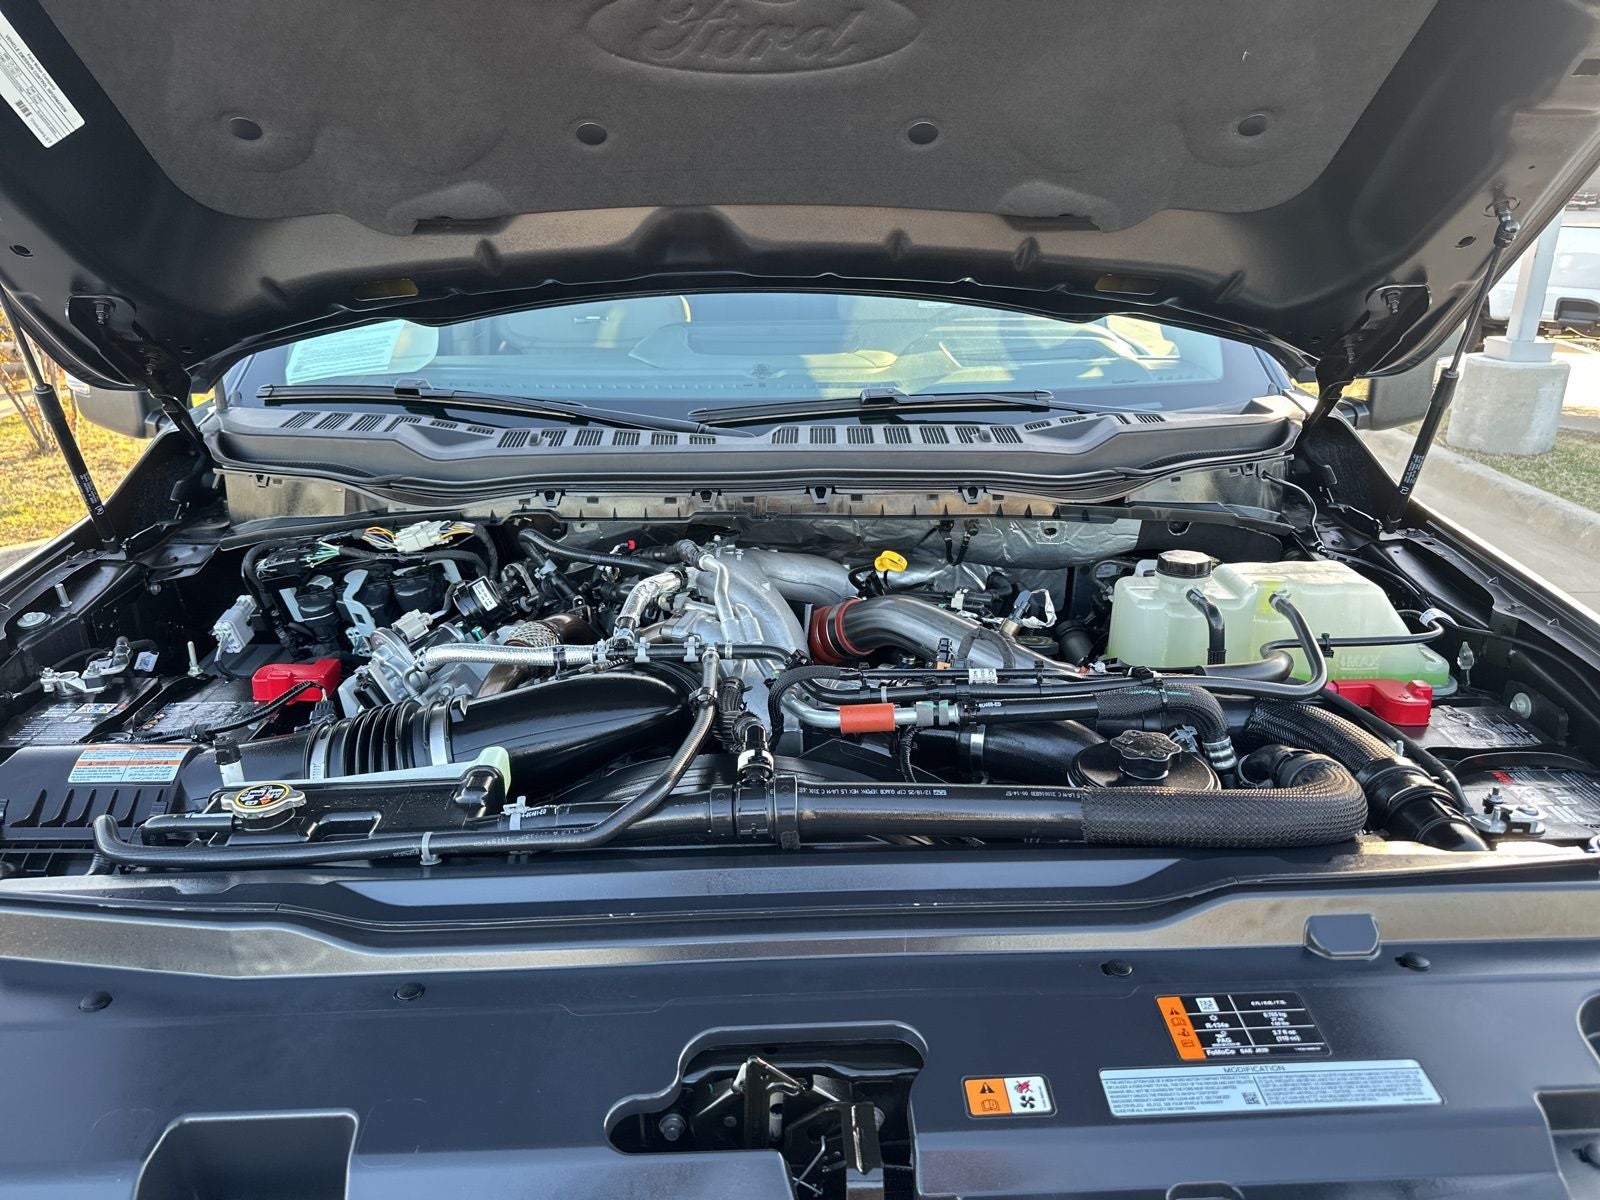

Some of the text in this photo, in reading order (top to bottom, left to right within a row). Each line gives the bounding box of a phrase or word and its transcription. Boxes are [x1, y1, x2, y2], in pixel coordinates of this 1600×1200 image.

[637, 0, 865, 62] Ford
[6, 34, 20, 52] VEHICLE
[32, 70, 47, 88] CONTROL
[47, 88, 67, 113] INFORMATION
[1223, 1064, 1286, 1074] MODIFICATION
